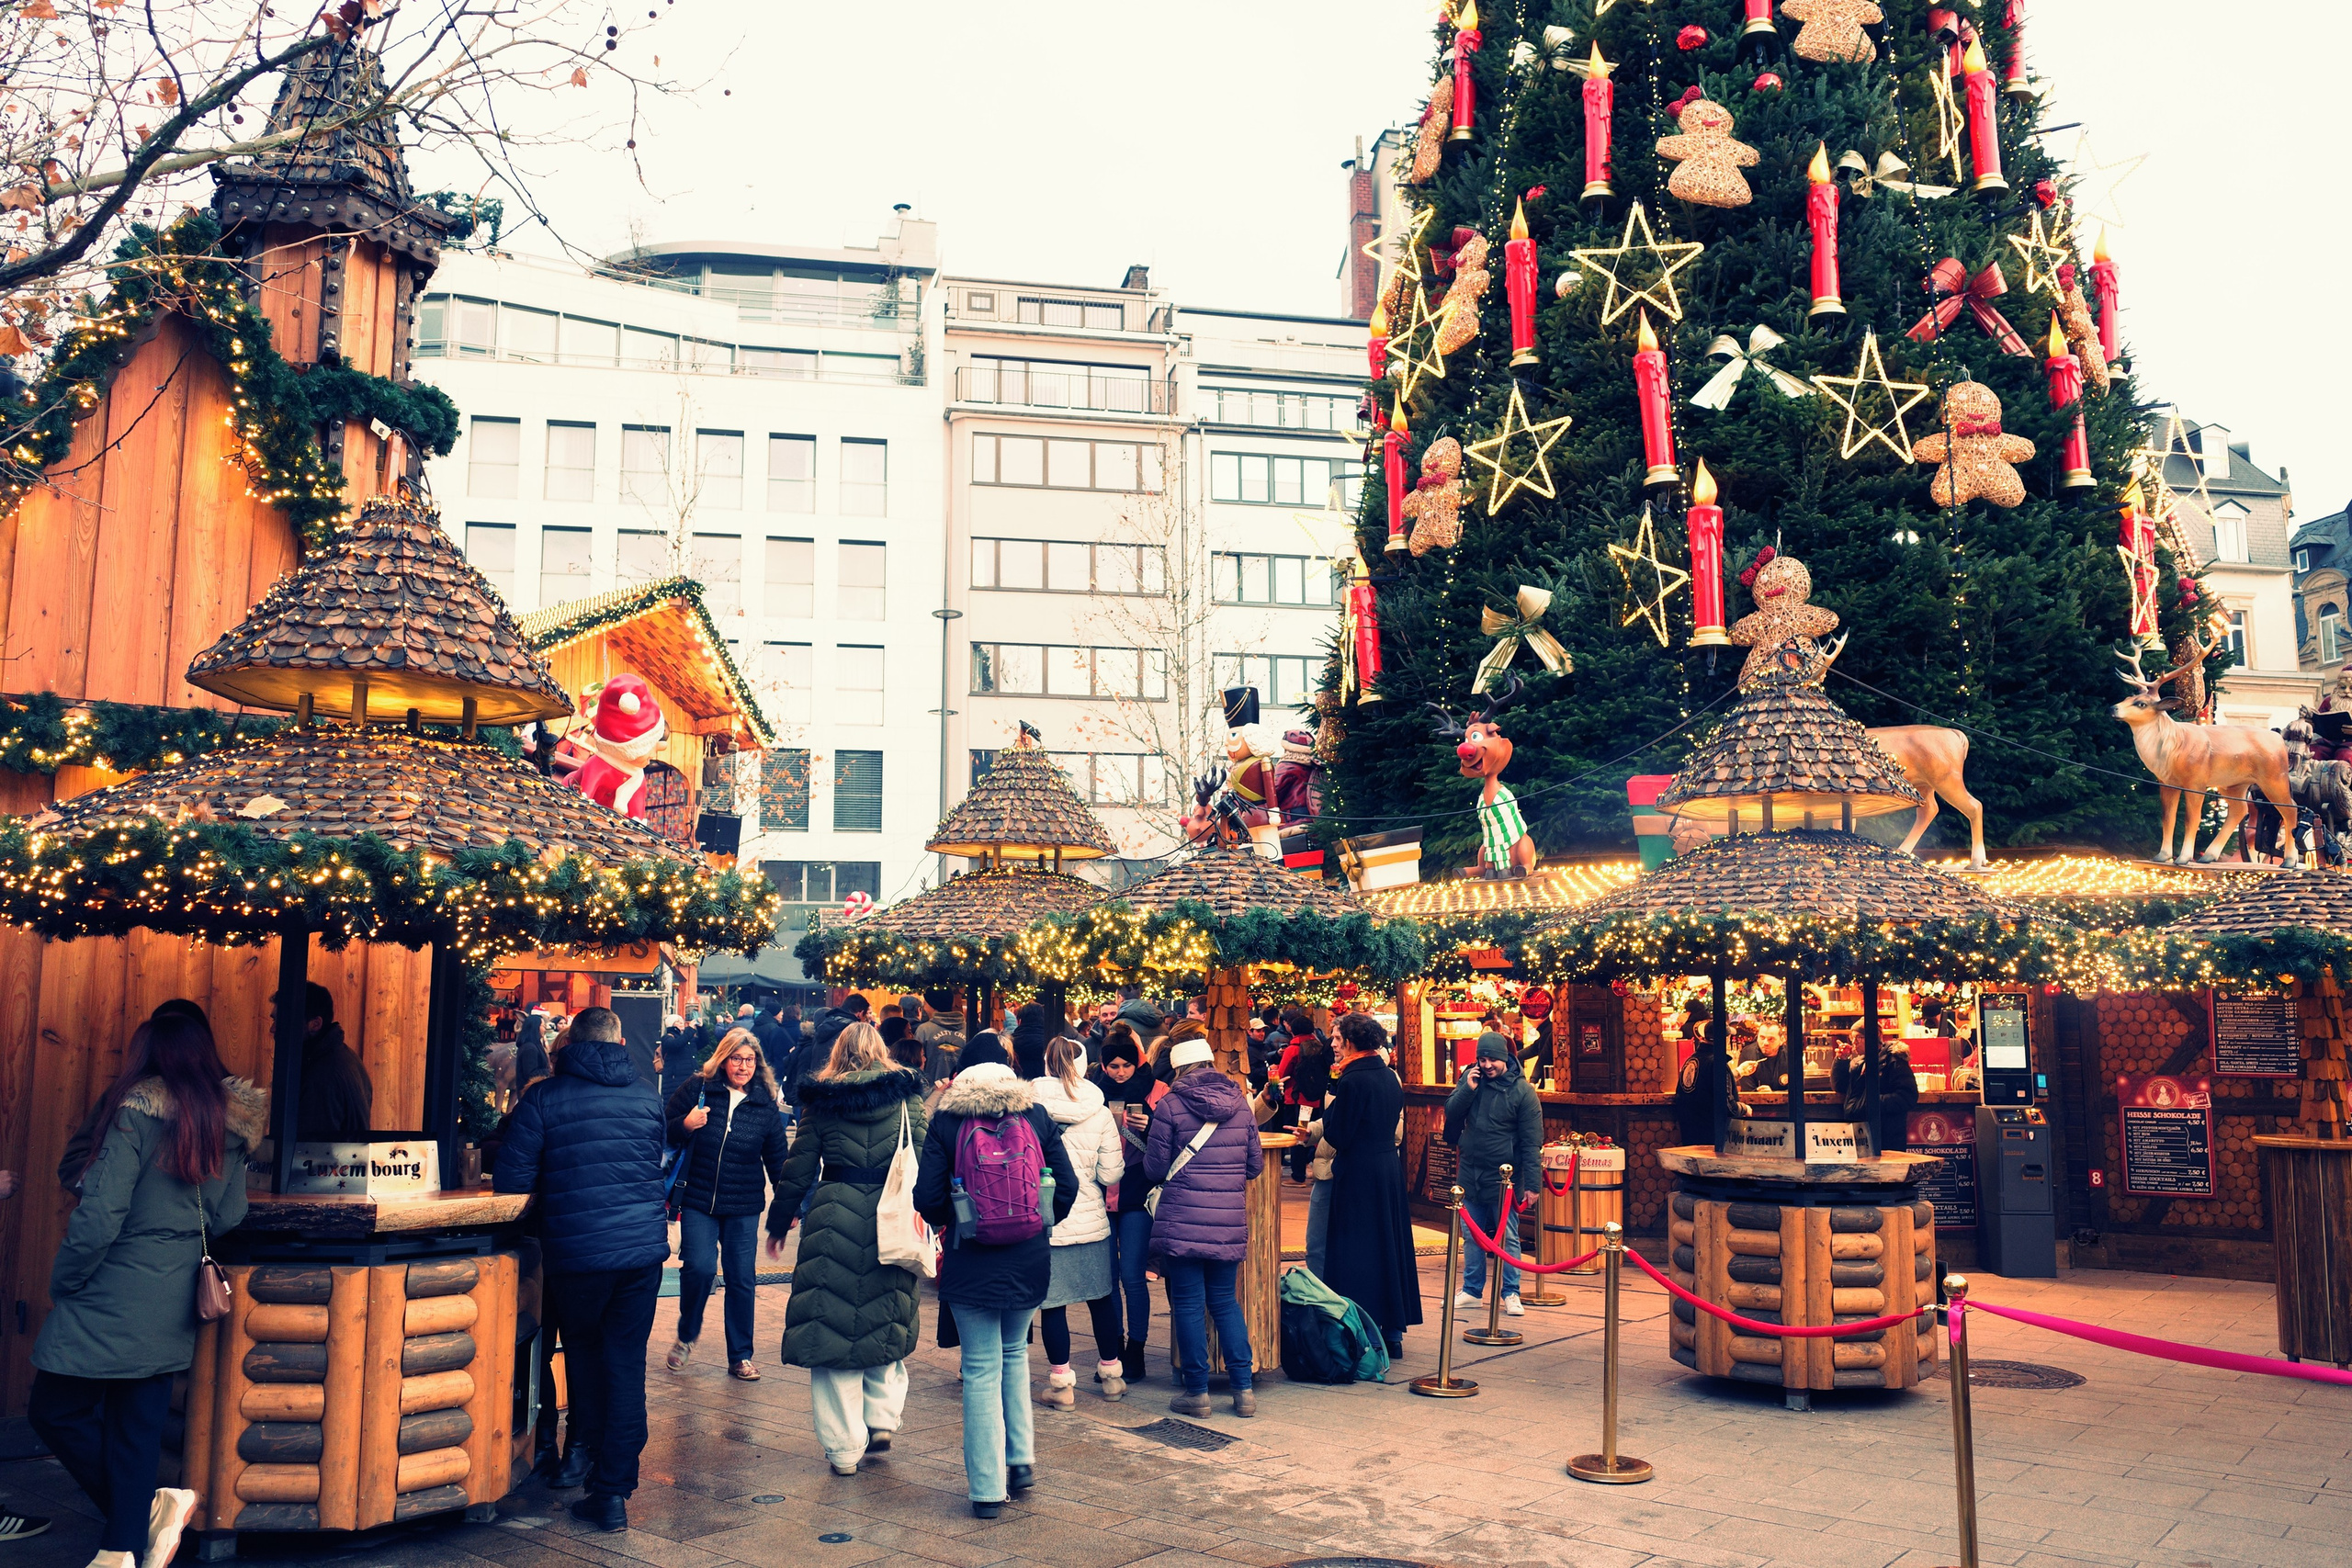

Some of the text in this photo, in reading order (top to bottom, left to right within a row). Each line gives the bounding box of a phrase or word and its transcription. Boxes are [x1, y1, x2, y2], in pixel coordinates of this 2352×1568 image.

[933, 1030, 953, 1041] SALTY
[302, 1159, 421, 1180] Luxembourg
[2092, 1171, 2101, 1185] 8
